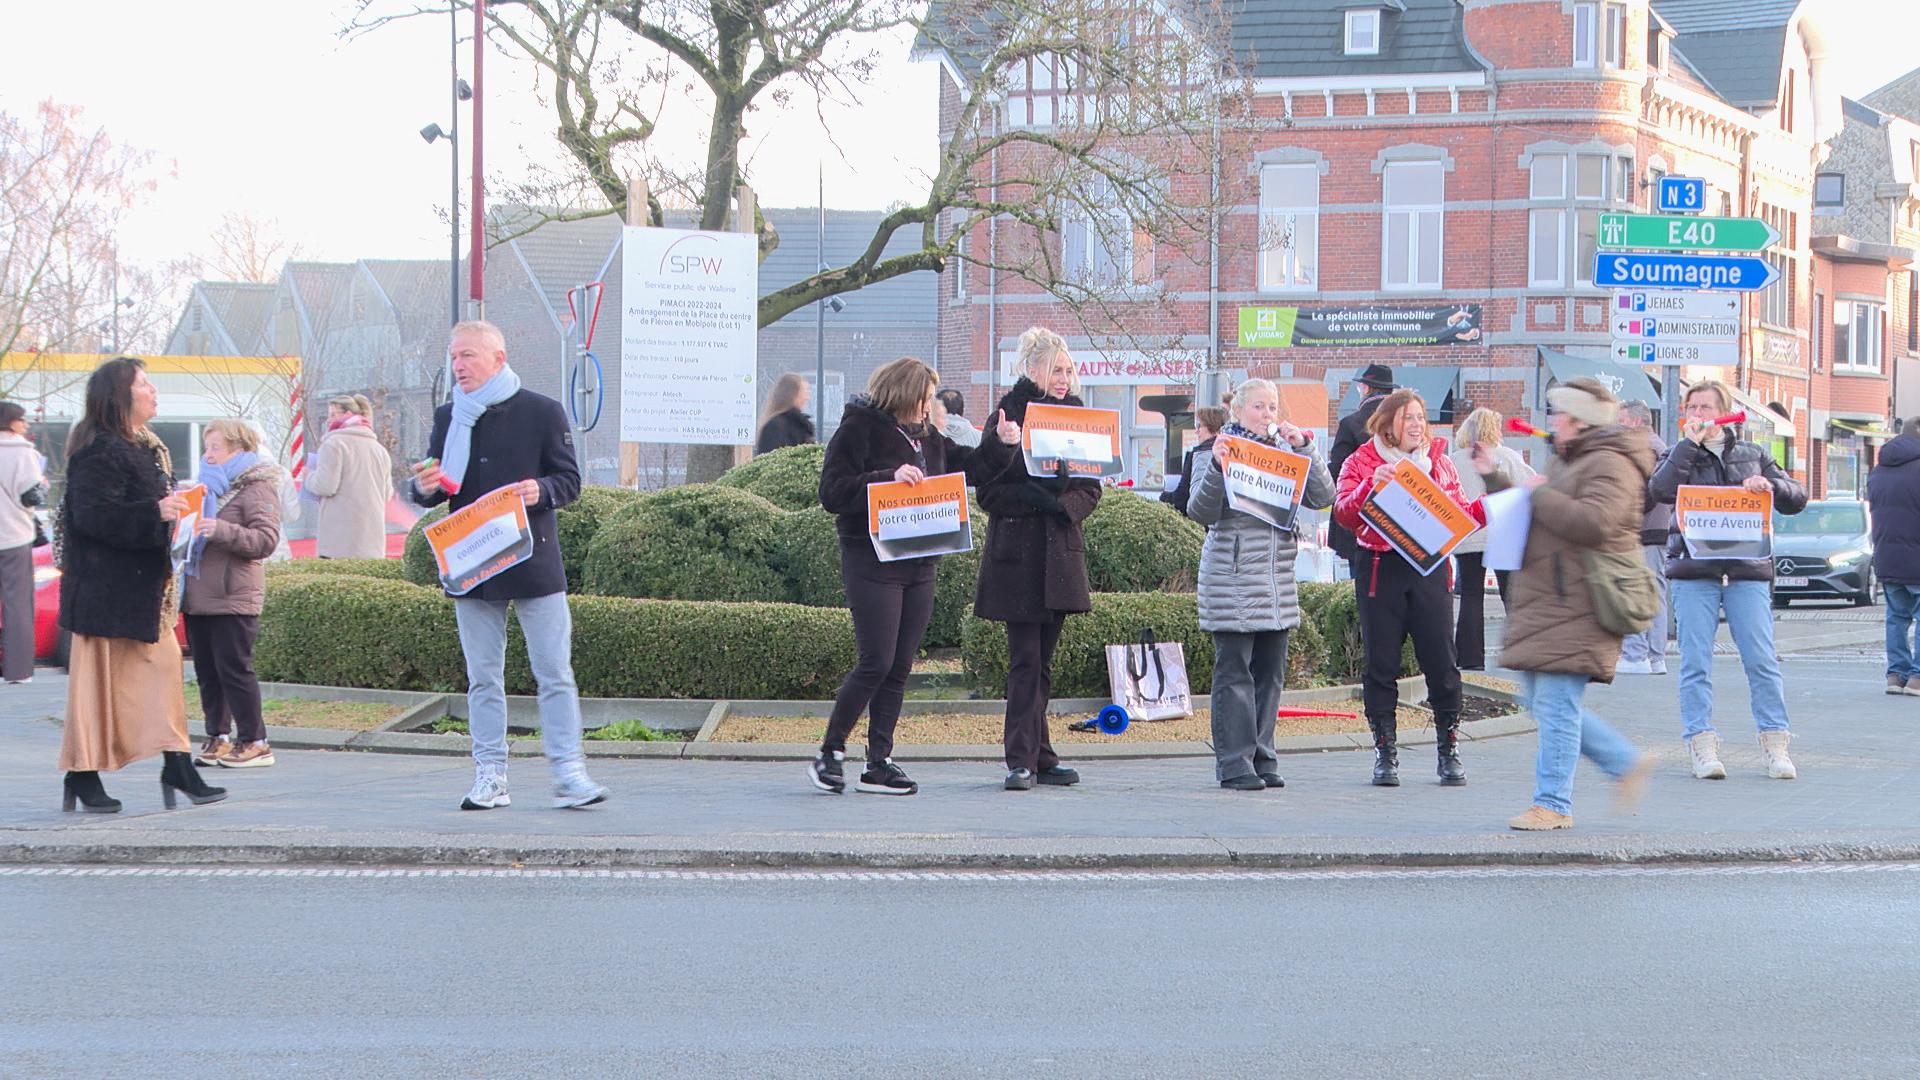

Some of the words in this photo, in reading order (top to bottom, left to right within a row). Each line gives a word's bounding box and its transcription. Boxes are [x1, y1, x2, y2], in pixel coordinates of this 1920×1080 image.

[1668, 186, 1678, 206] N
[1684, 183, 1696, 206] 3
[1669, 221, 1716, 245] E40
[671, 255, 723, 275] SPW
[1613, 258, 1742, 289] Soumagne
[688, 300, 722, 309] 2022-2024
[1634, 295, 1644, 310] P
[1648, 297, 1684, 310] JEHAES
[699, 311, 718, 319] Place
[1312, 312, 1324, 321] Le
[1326, 310, 1379, 322] spécialiste
[1381, 310, 1436, 321] immobilier
[1328, 322, 1341, 332] de
[1343, 323, 1369, 332] votre
[1372, 323, 1422, 332] commune
[1644, 320, 1655, 334] P
[1657, 322, 1736, 336] ADMINISTRATION
[1348, 337, 1375, 345] expertise
[1643, 345, 1654, 359] P
[1657, 347, 1684, 359] LIGNE
[1686, 347, 1699, 359] 38
[1067, 460, 1103, 474] Social
[1248, 452, 1273, 470] Tuez
[1275, 461, 1298, 477] Pas
[1255, 476, 1300, 497] Avenue
[1401, 471, 1417, 488] Pas
[878, 499, 898, 509] Nos
[901, 490, 961, 506] commerces
[1682, 496, 1702, 507] Ne
[1706, 496, 1737, 508] Tuez
[1741, 497, 1762, 508] Pas
[878, 514, 907, 525] votre
[910, 507, 960, 527] quotidien
[1720, 517, 1769, 529] Avenue
